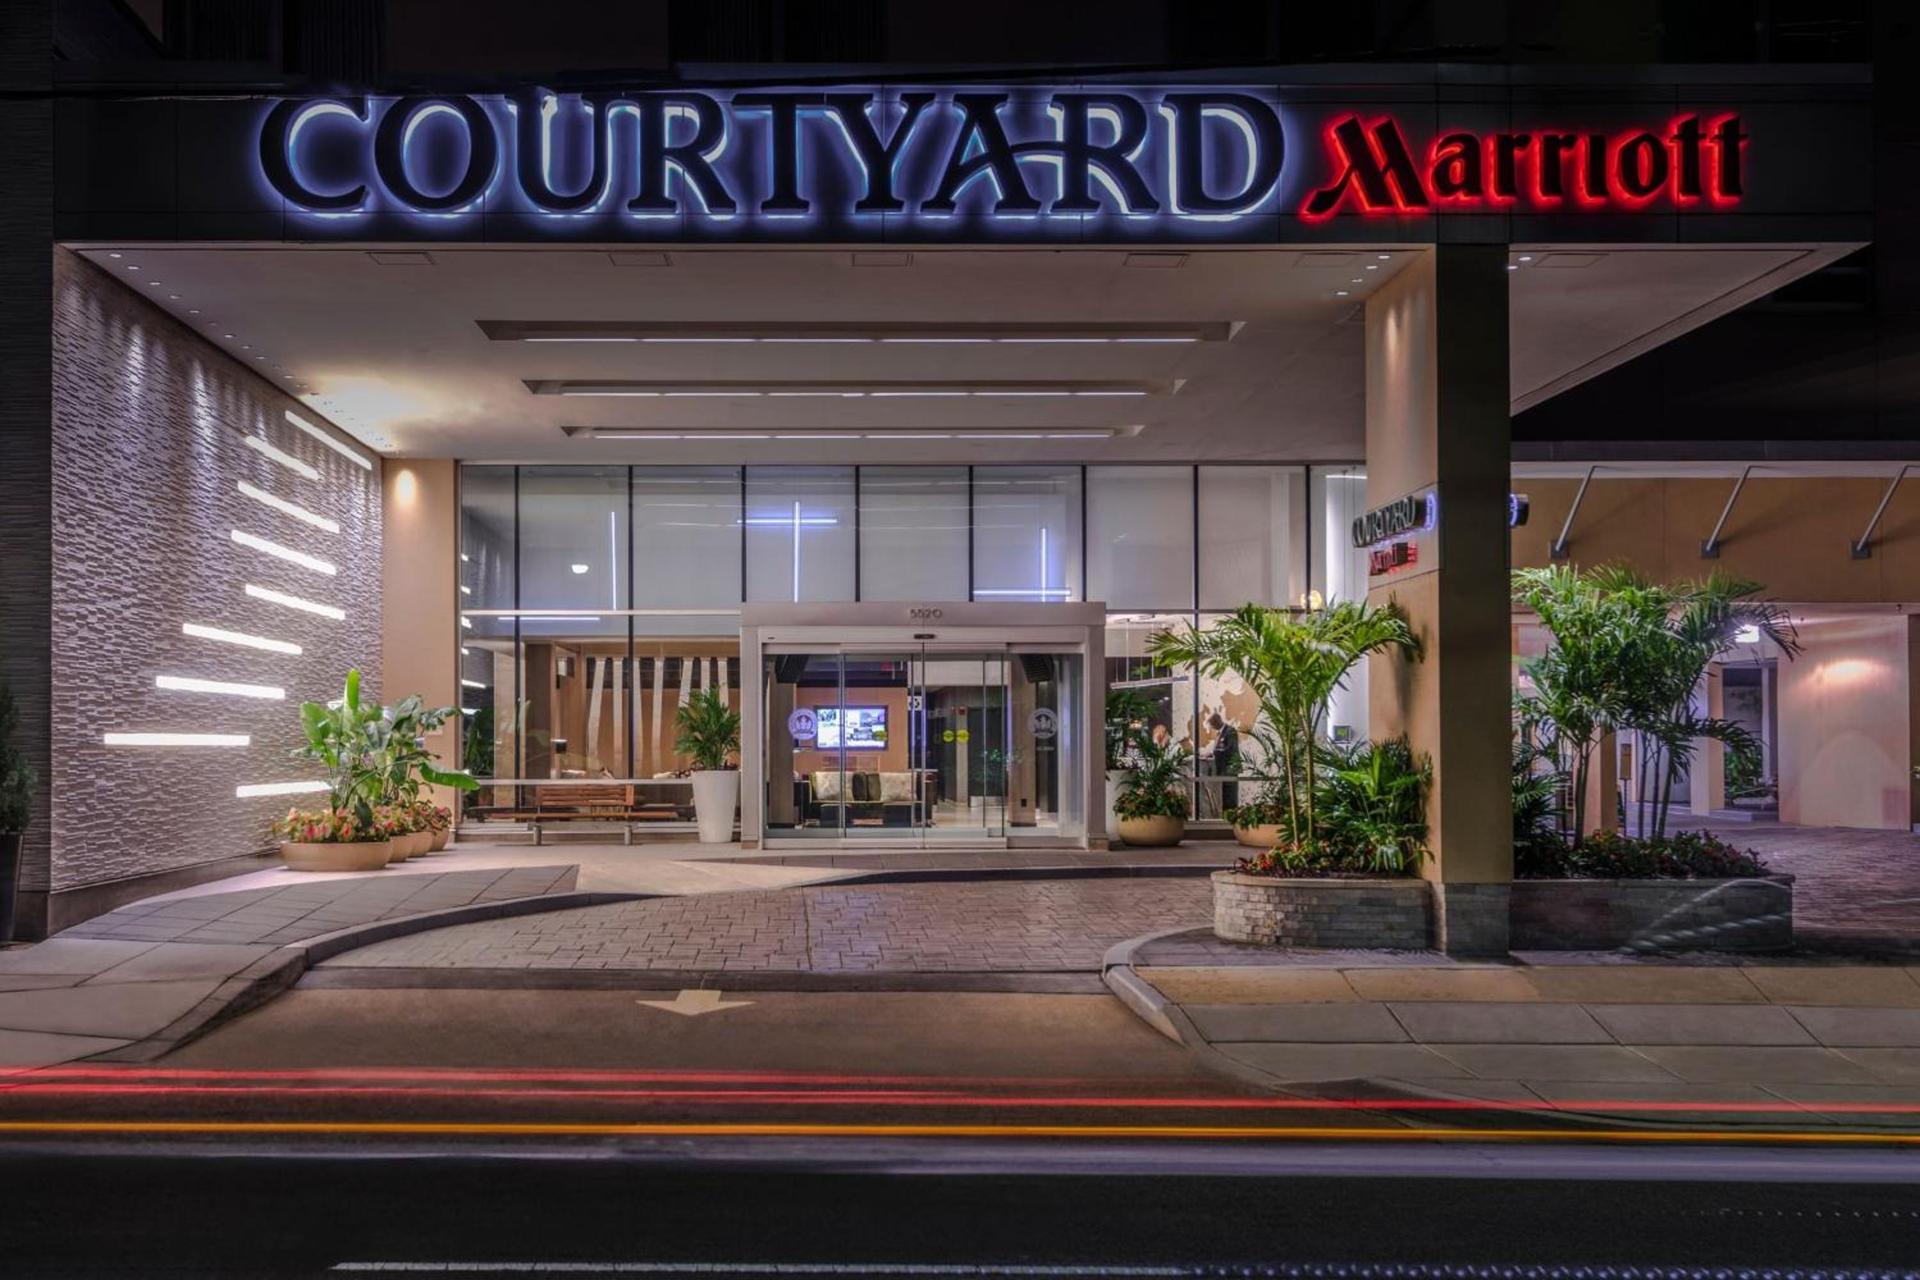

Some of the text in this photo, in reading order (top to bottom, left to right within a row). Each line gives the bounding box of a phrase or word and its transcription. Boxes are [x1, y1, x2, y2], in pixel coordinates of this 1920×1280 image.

[259, 93, 1748, 216] COURTYARD Marriott
[910, 608, 943, 619] 5520
